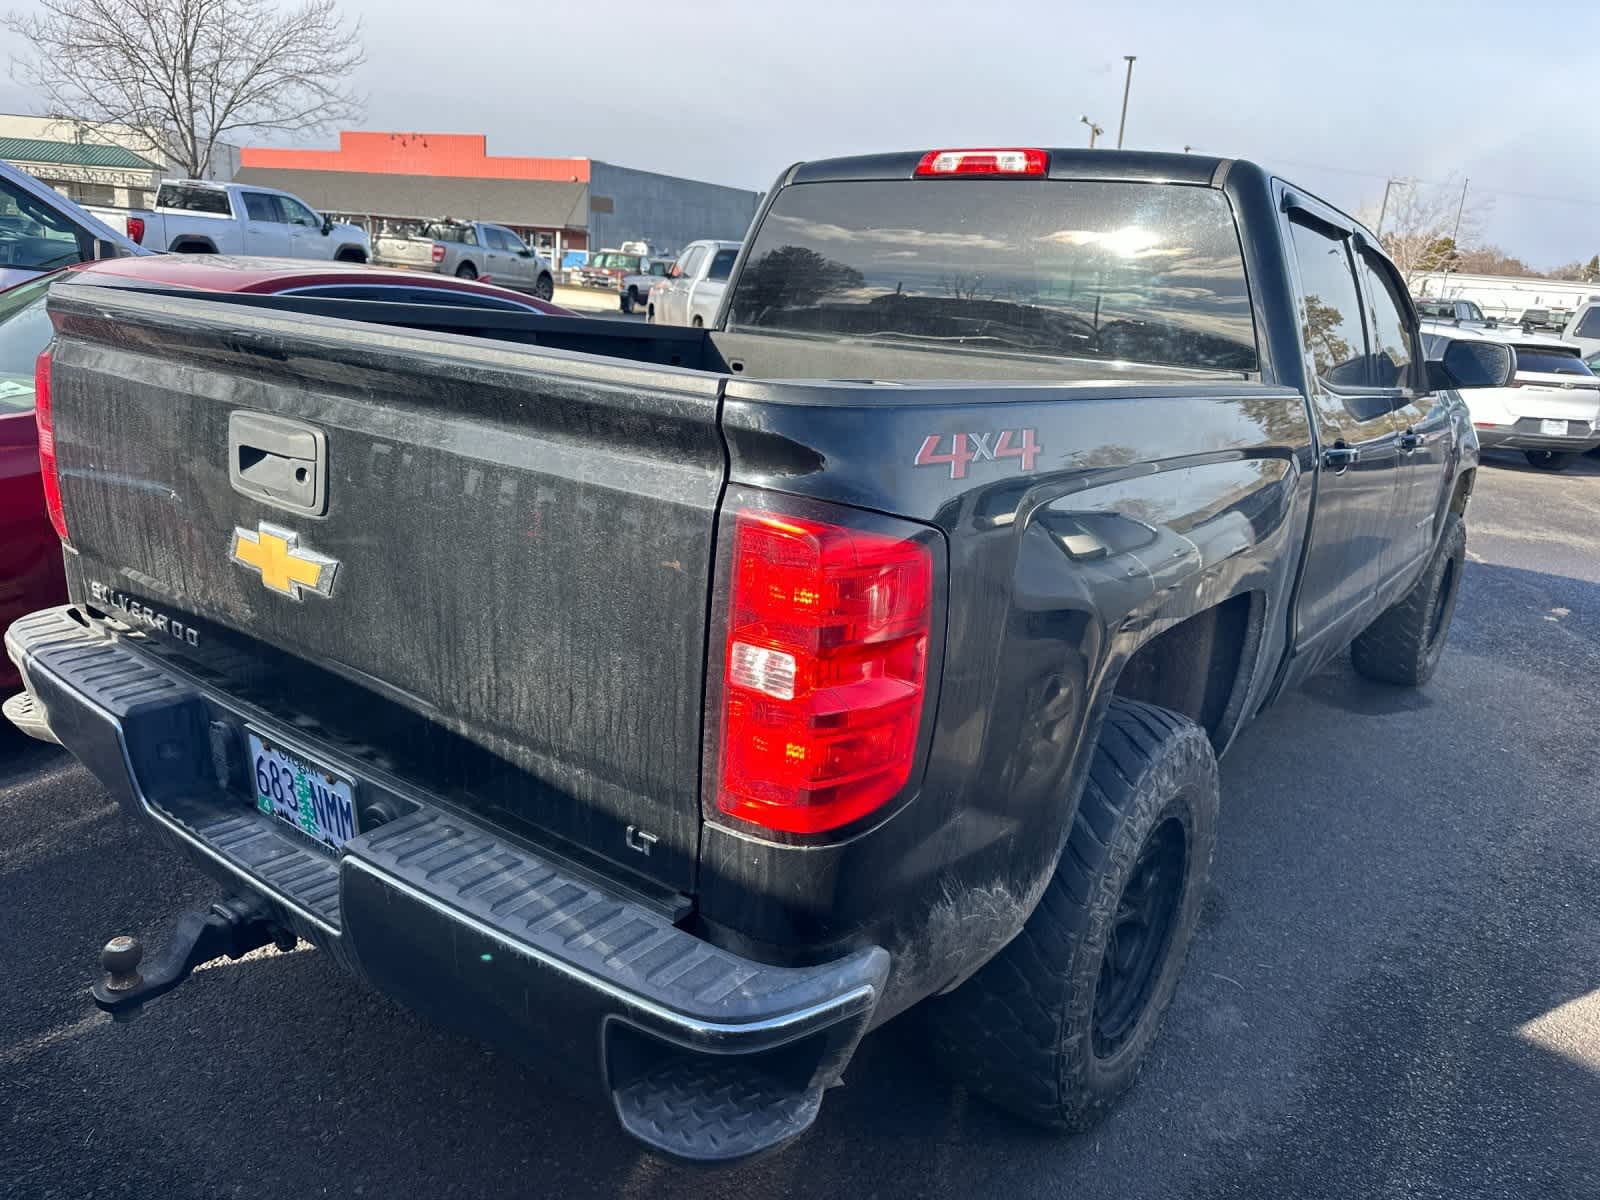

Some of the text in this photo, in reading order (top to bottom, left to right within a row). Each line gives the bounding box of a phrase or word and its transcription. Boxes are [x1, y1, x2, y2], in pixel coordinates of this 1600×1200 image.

[90, 580, 199, 647] SILVERADO
[256, 755, 354, 841] 683 NMM
[626, 825, 657, 856] LT
